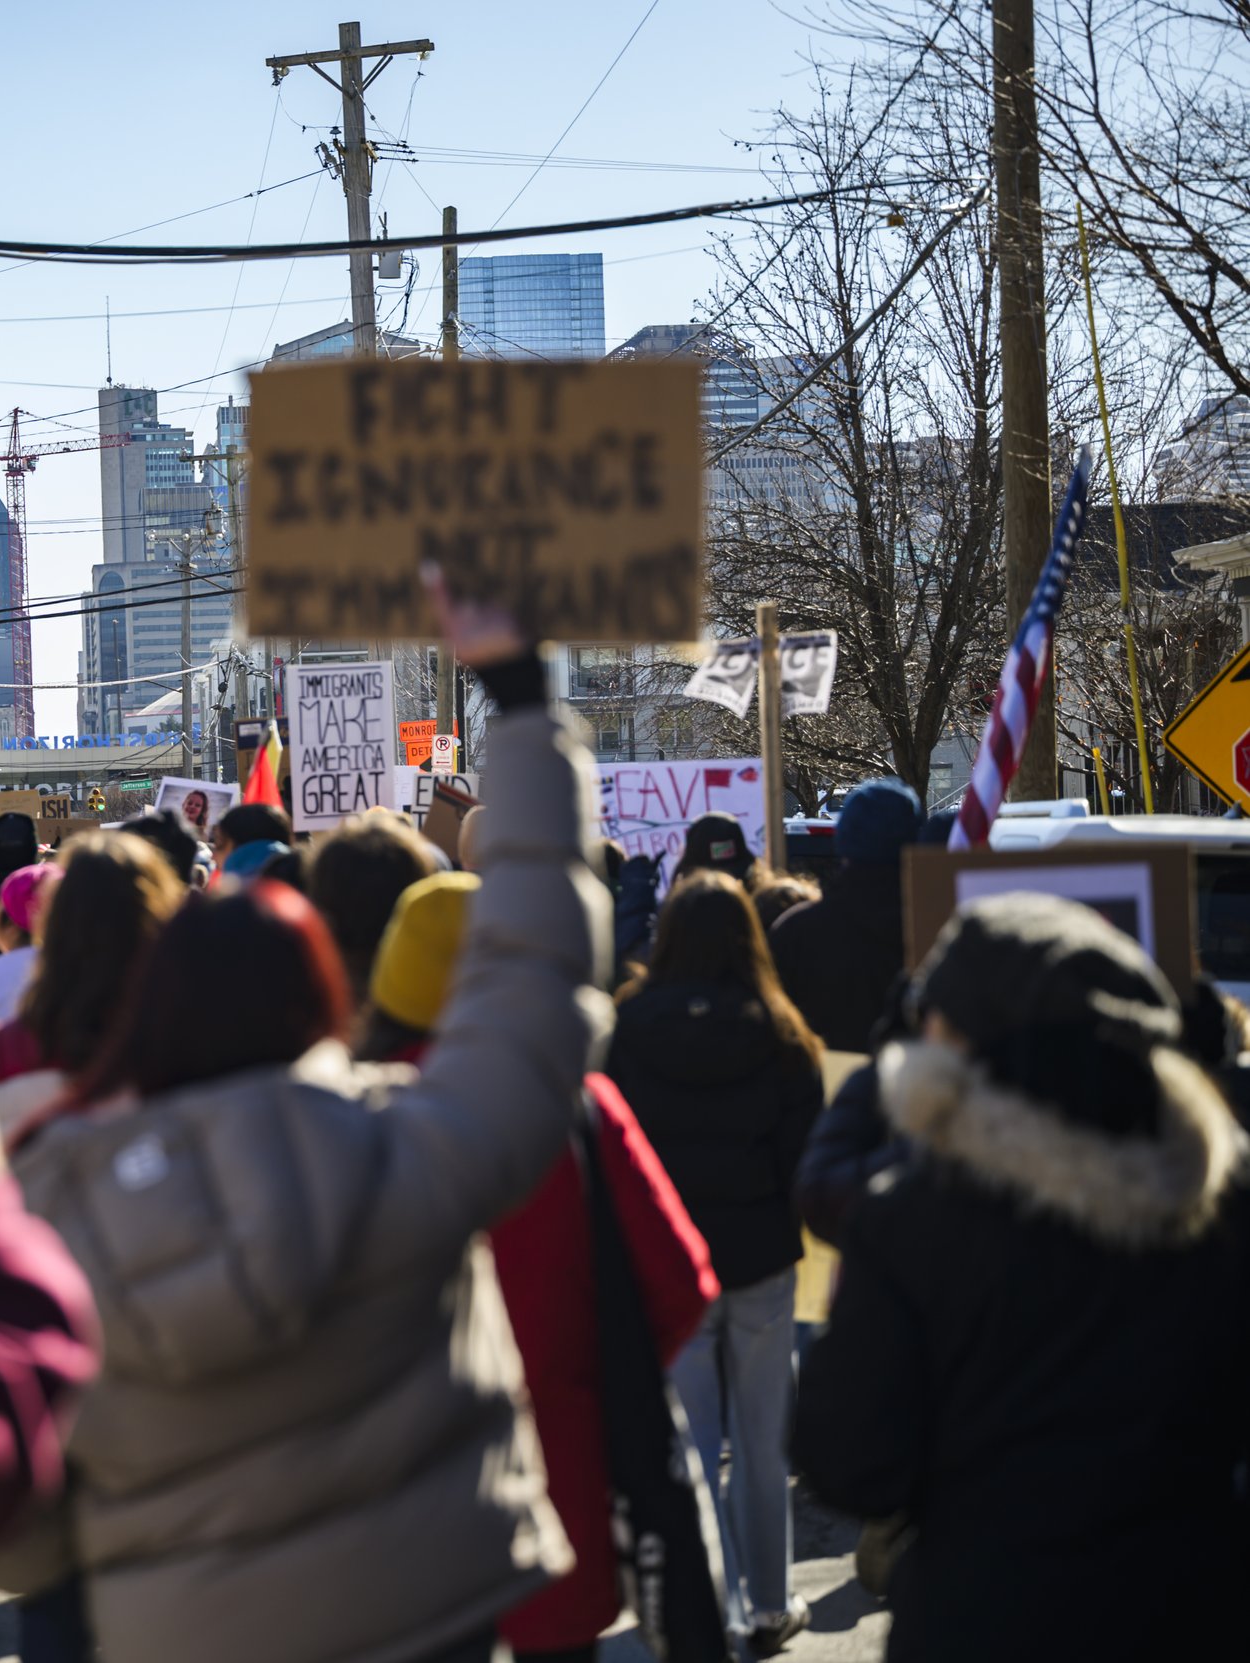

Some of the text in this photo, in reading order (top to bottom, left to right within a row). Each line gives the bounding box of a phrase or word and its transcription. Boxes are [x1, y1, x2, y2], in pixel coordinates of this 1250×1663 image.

[263, 427, 666, 524] IGNORANCE
[257, 541, 696, 639] IMMANTS
[298, 672, 383, 699] IMMIGRANTS
[299, 698, 385, 744] MAKE
[402, 724, 437, 737] MONROE
[301, 744, 385, 772] AMERICA
[411, 746, 432, 757] DET
[42, 799, 69, 818] ISH
[302, 771, 385, 815] GREAT
[601, 766, 749, 819] EAVE
